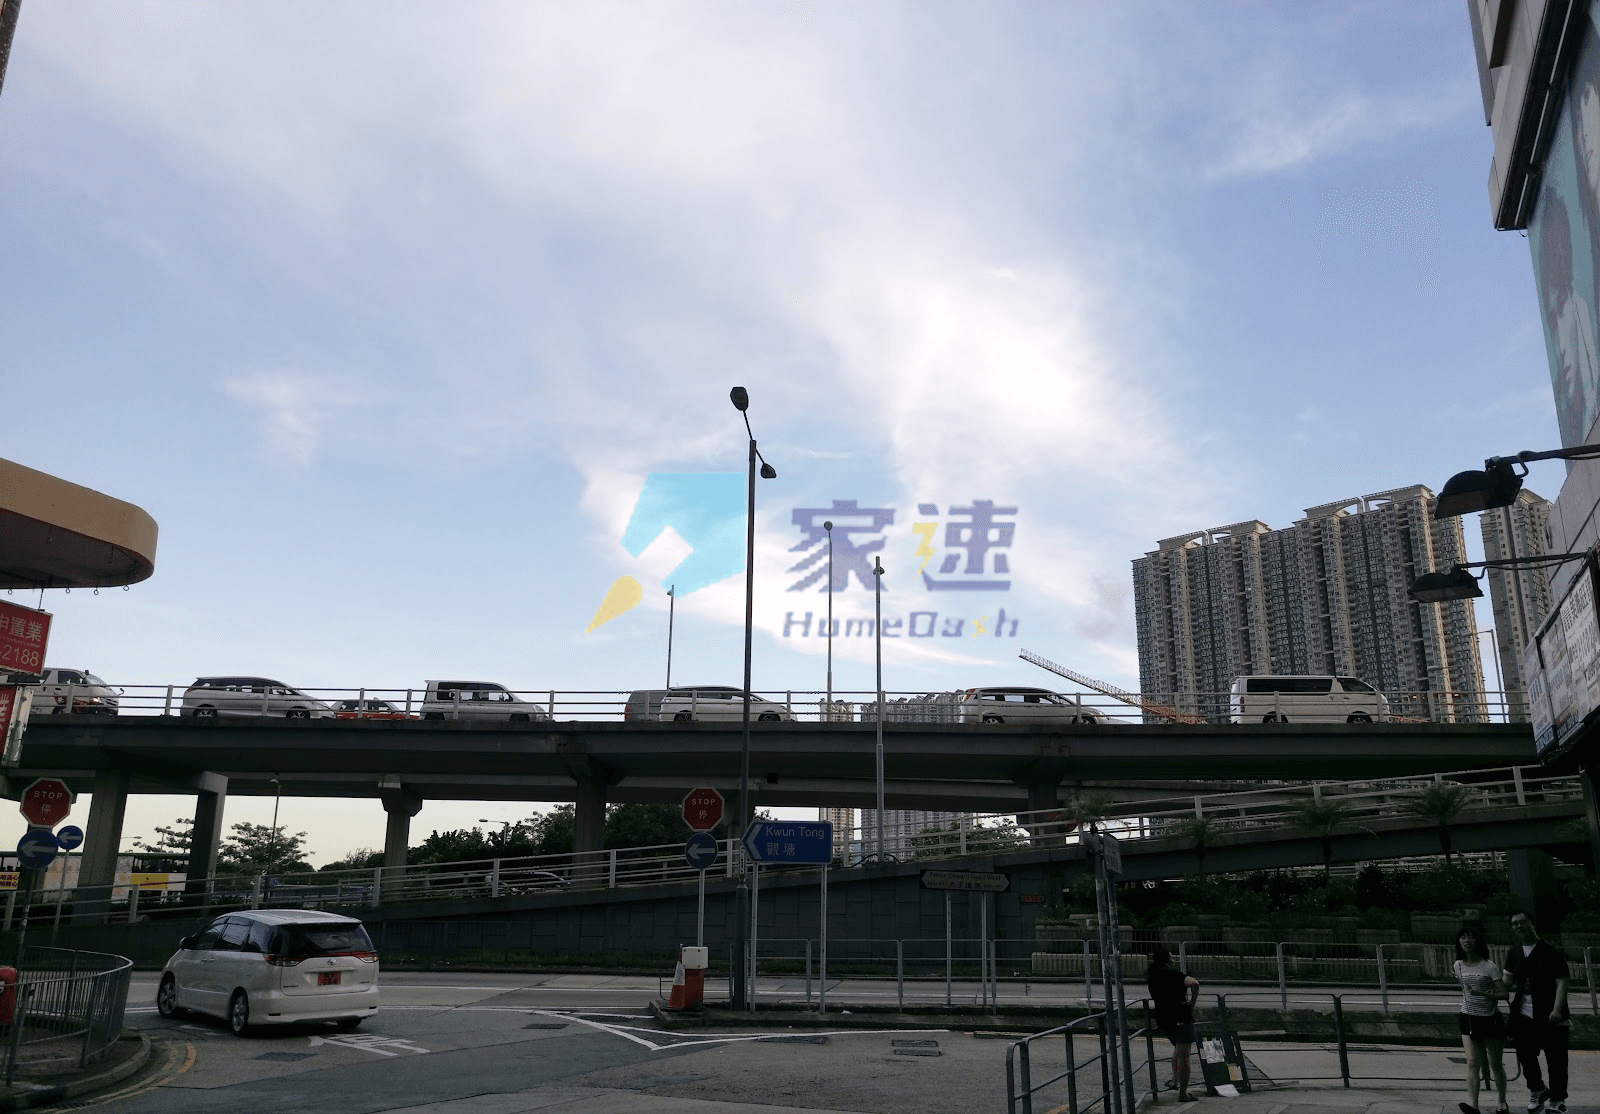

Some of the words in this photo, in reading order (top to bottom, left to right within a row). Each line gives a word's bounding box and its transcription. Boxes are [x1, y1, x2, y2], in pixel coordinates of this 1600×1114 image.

[33, 790, 63, 799] STOP
[691, 798, 716, 806] STOP
[40, 803, 52, 814] 停
[698, 809, 708, 820] 停
[765, 826, 795, 837] Kwun
[798, 826, 825, 840] Tong
[766, 842, 796, 856] 觀塘
